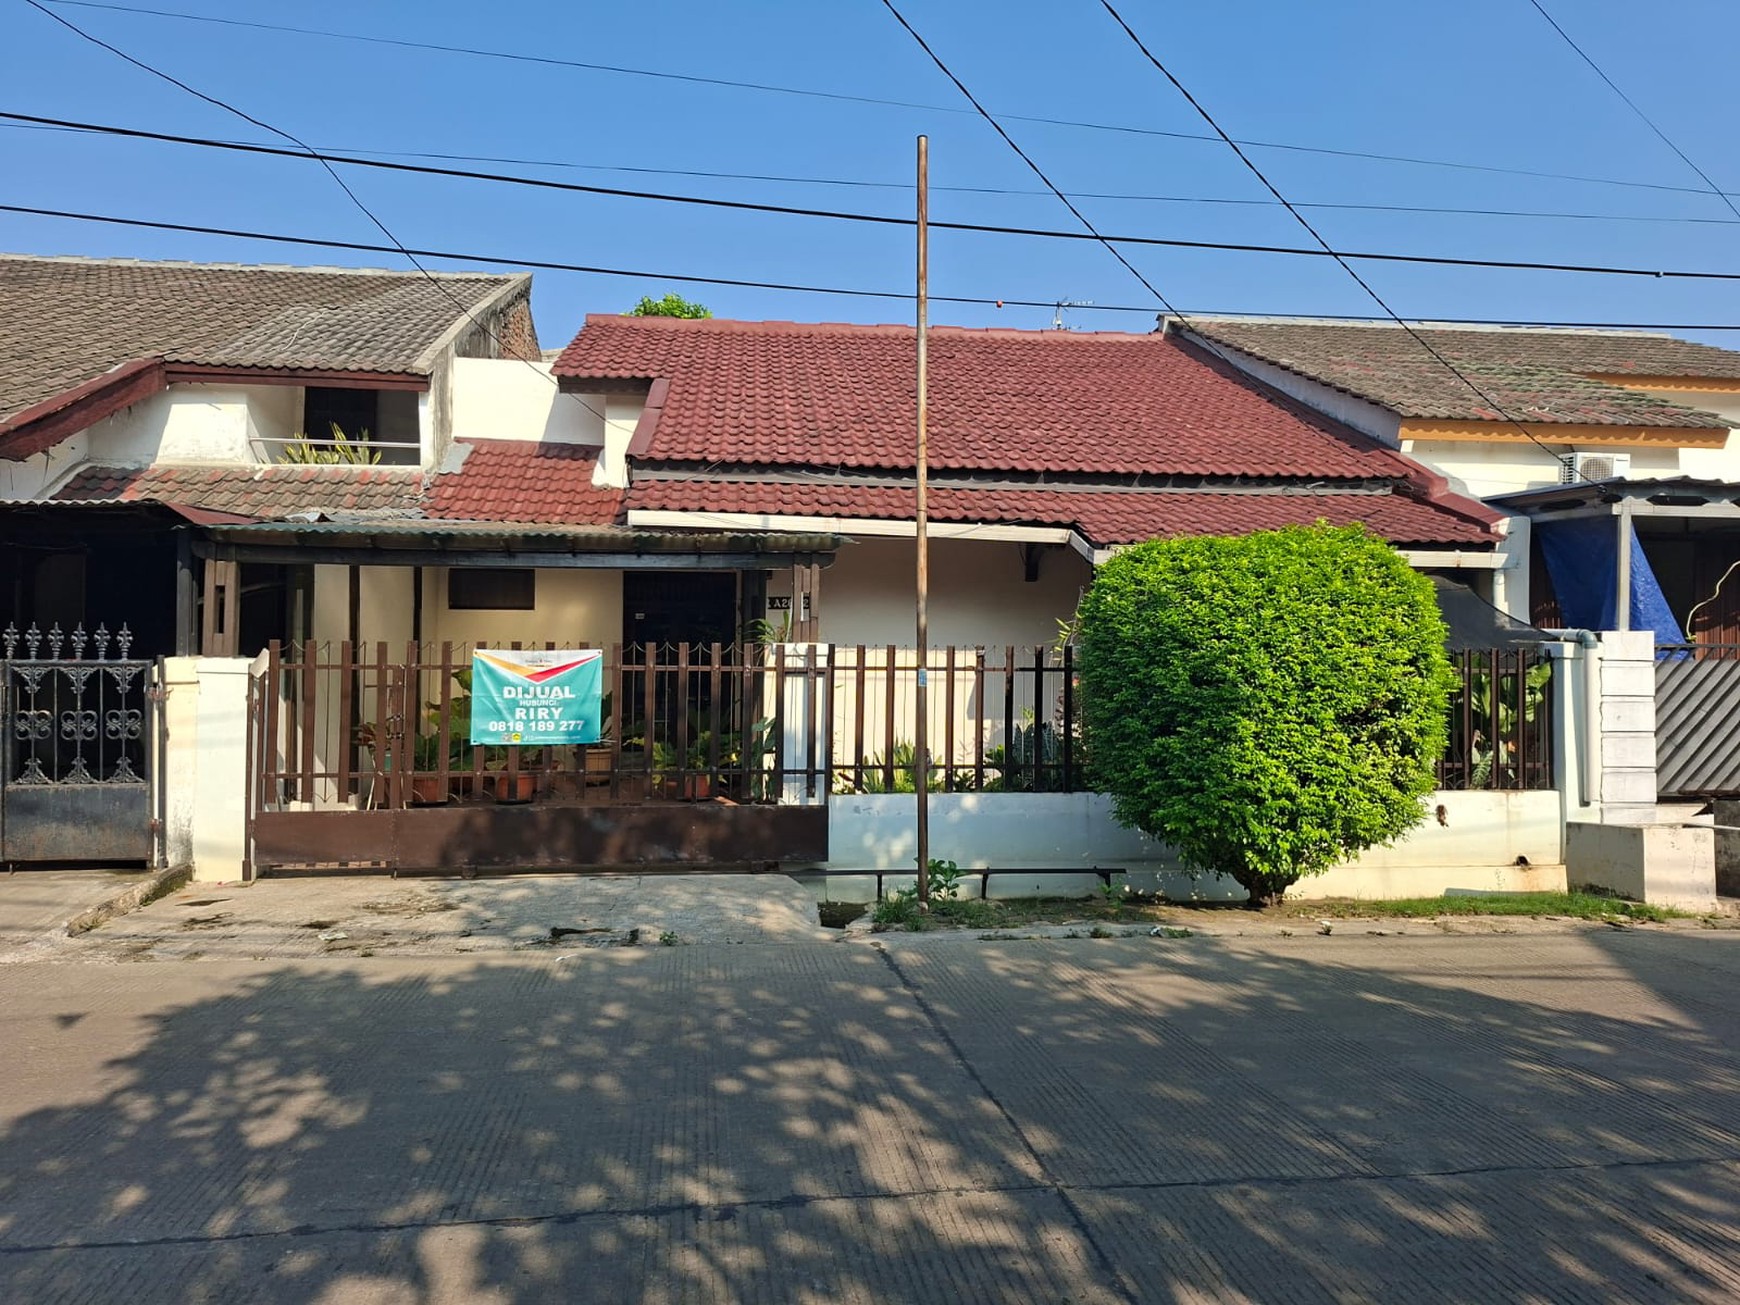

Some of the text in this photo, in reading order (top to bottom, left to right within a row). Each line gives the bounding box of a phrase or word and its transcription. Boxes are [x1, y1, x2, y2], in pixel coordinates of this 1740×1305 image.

[503, 686, 576, 699] DIJUAL
[514, 707, 563, 720] RIRY
[488, 720, 584, 732] 0818 189 277
